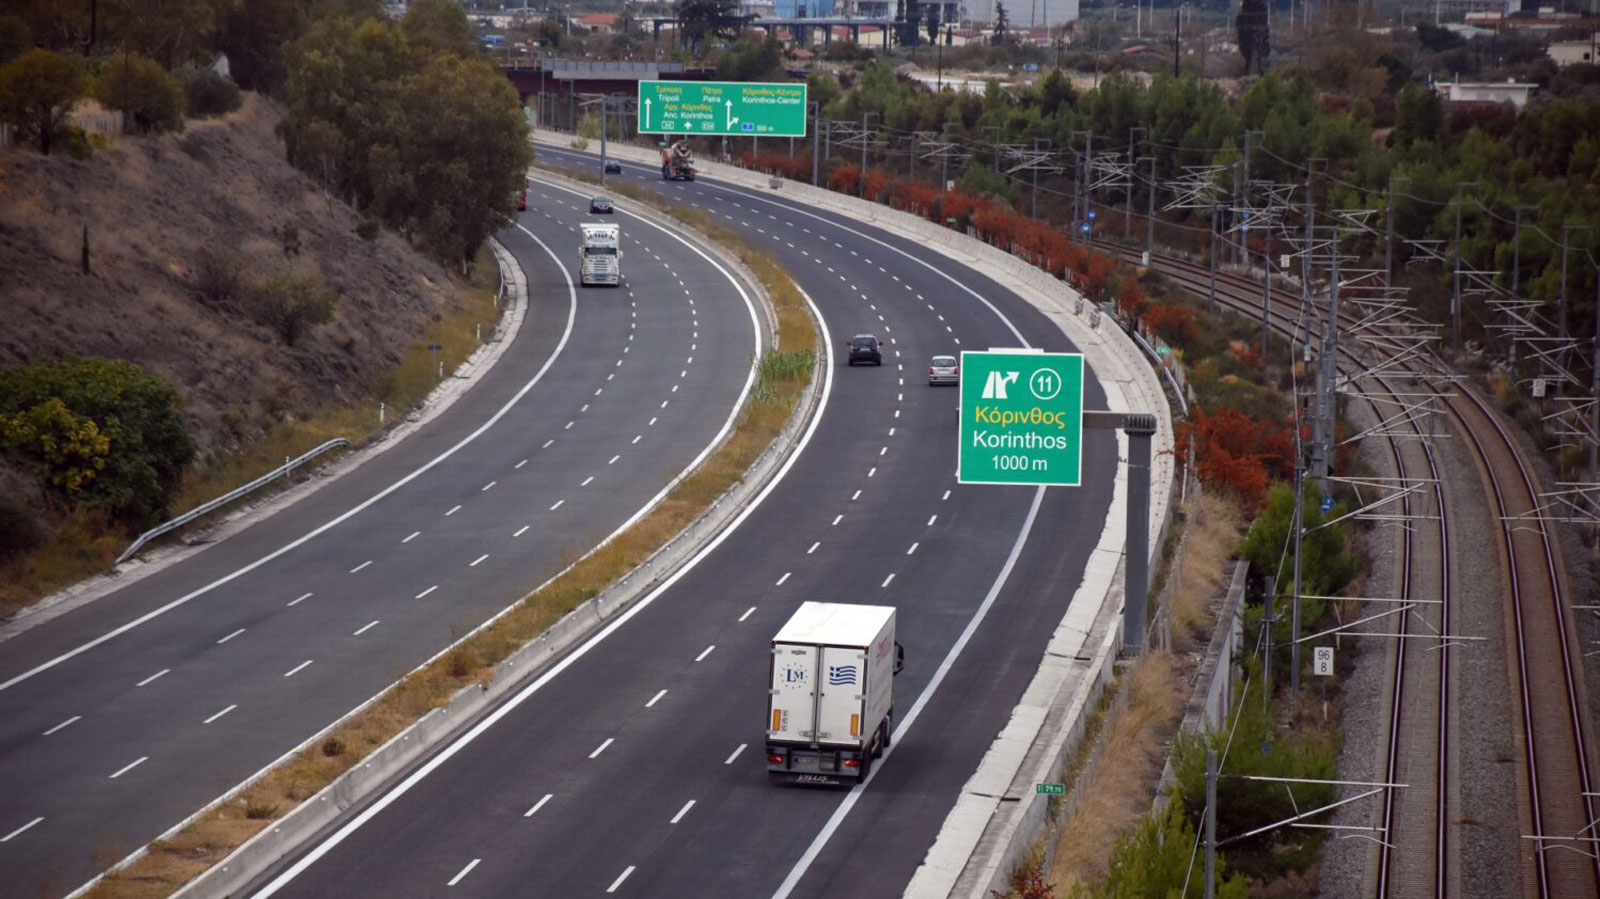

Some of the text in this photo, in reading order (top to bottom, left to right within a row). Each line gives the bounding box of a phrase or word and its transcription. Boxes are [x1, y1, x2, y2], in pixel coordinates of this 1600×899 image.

[658, 94, 680, 102] Tripoli
[702, 95, 721, 103] Patra
[742, 96, 801, 104] Korinthos-Center
[680, 112, 713, 120] Korinthos
[1037, 376, 1052, 393] 11
[975, 406, 1065, 429] Κόρινθος
[973, 430, 1067, 449] Korinthos
[992, 455, 1048, 471] 1000 m
[1318, 649, 1330, 660] 96
[1321, 662, 1327, 672] 8
[786, 668, 804, 683] LM
